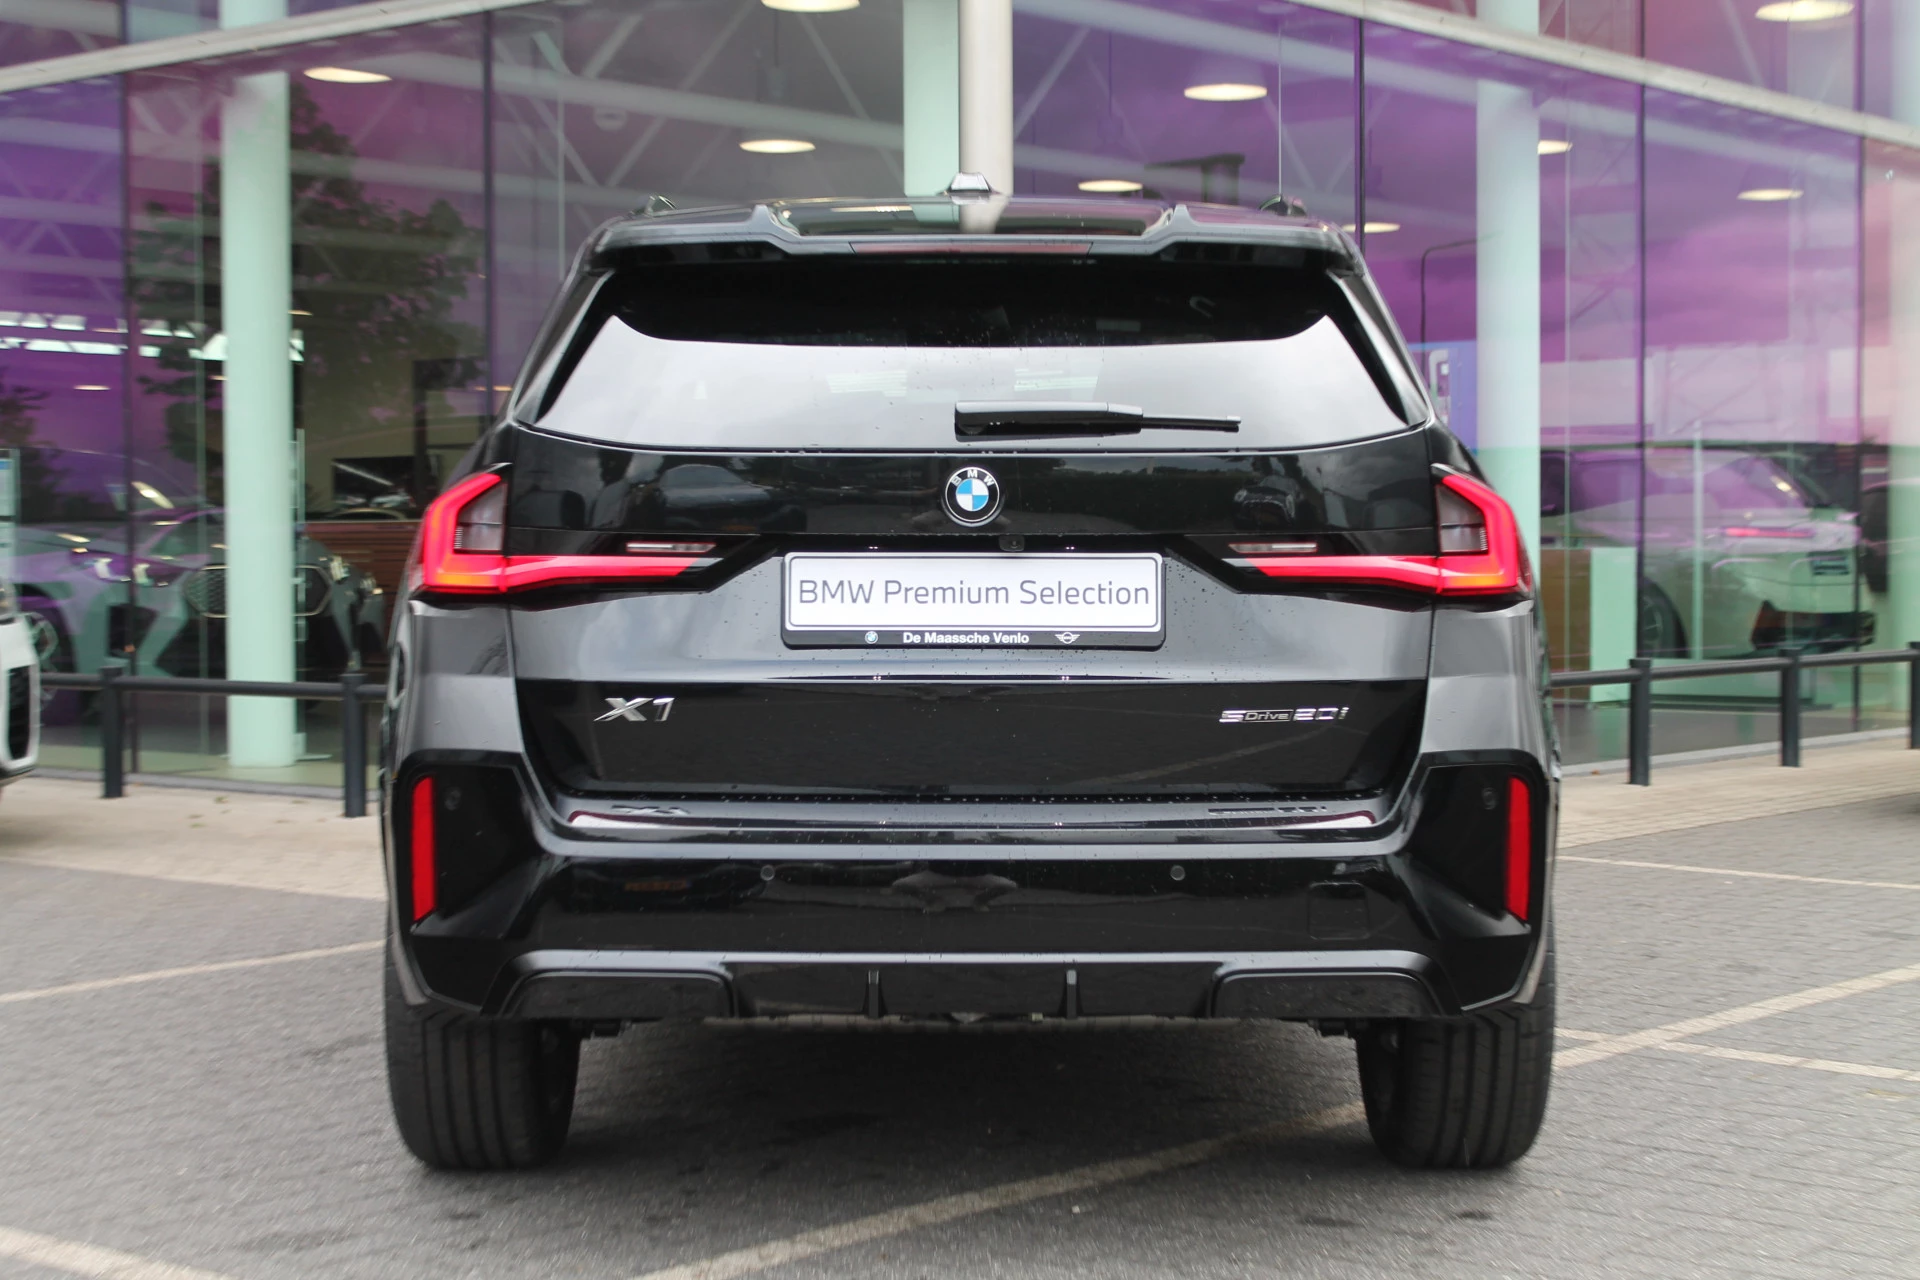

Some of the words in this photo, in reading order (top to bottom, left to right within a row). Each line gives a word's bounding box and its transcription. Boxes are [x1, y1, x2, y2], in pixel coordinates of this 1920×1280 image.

[950, 469, 995, 486] BMW
[799, 580, 874, 604] BMW
[884, 580, 1009, 604] Premium
[1019, 580, 1150, 605] Selection
[903, 632, 921, 644] De
[924, 632, 990, 644] Maassche
[993, 632, 1029, 644] Venlo
[593, 697, 675, 721] X1
